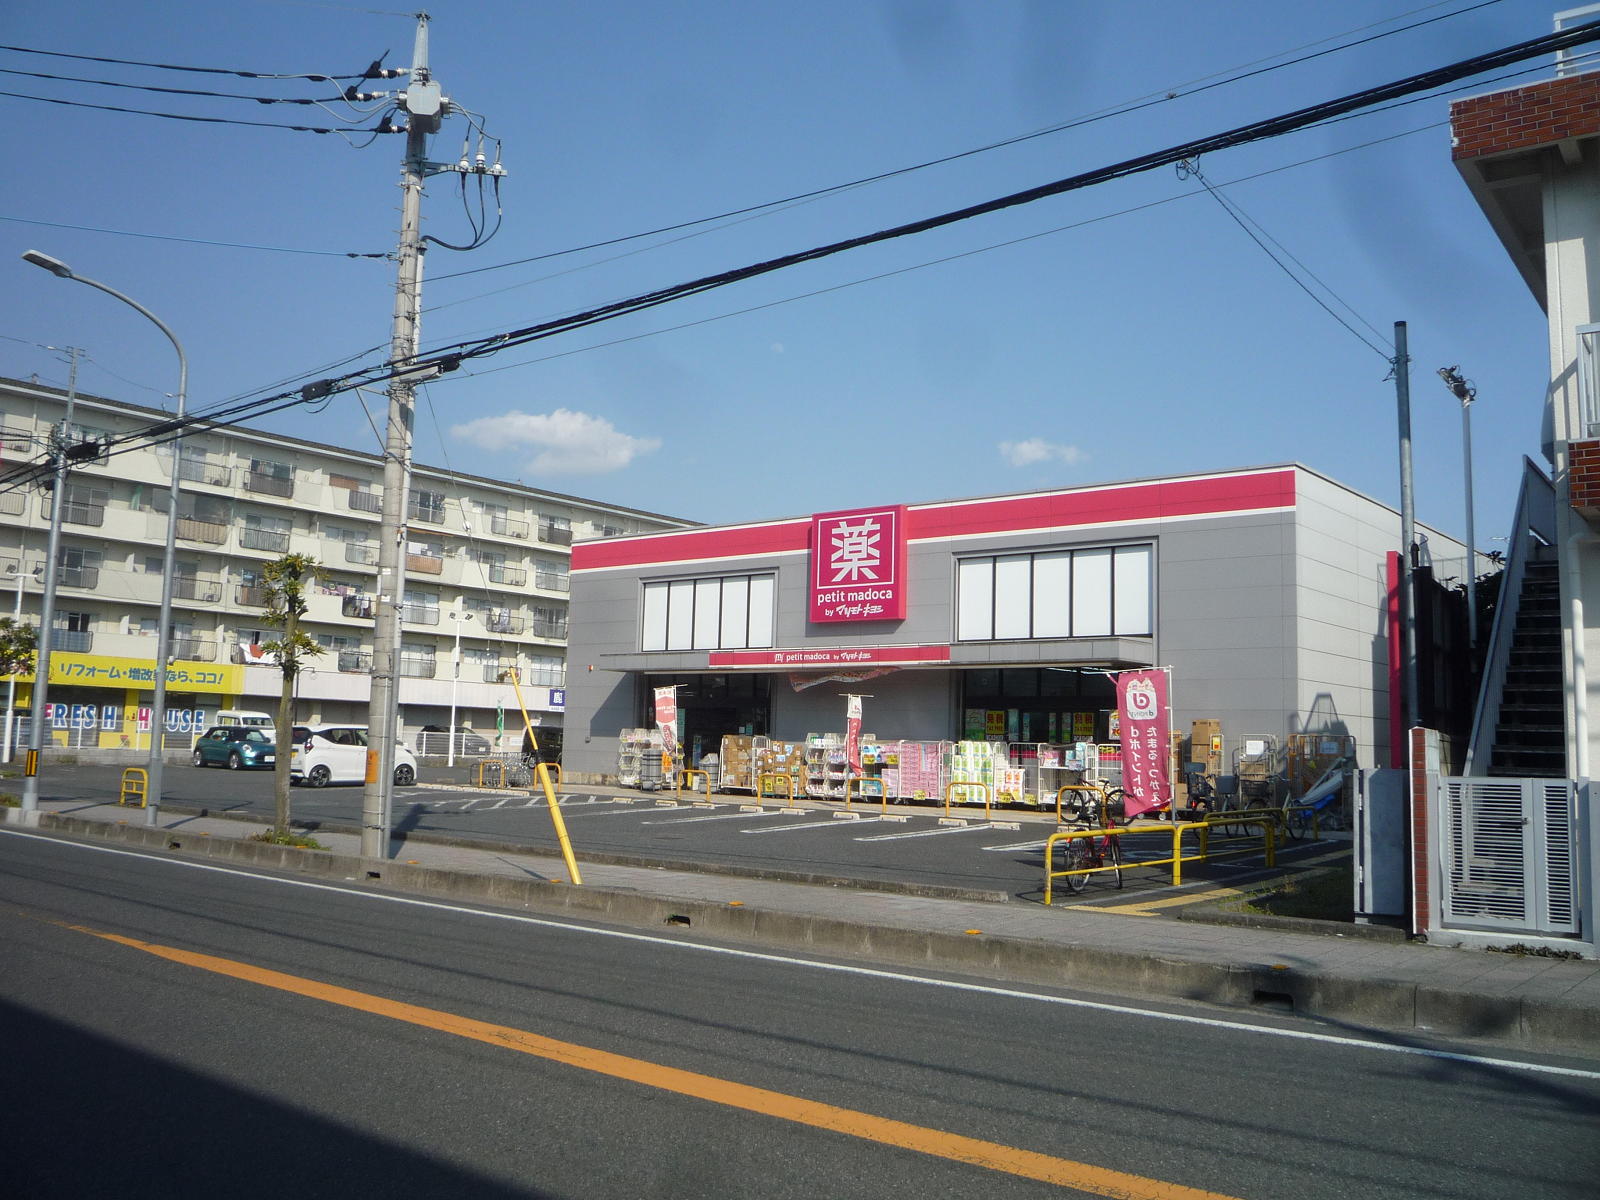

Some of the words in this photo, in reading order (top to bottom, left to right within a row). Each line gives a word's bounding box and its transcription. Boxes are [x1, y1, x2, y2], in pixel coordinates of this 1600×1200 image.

[831, 519, 880, 582] 薬
[817, 590, 845, 606] petit
[847, 587, 893, 602] madoca
[825, 608, 834, 617] by
[786, 653, 803, 663] petit
[803, 652, 830, 661] madoca
[44, 702, 118, 730] FRESH
[137, 707, 205, 733] HUSE
